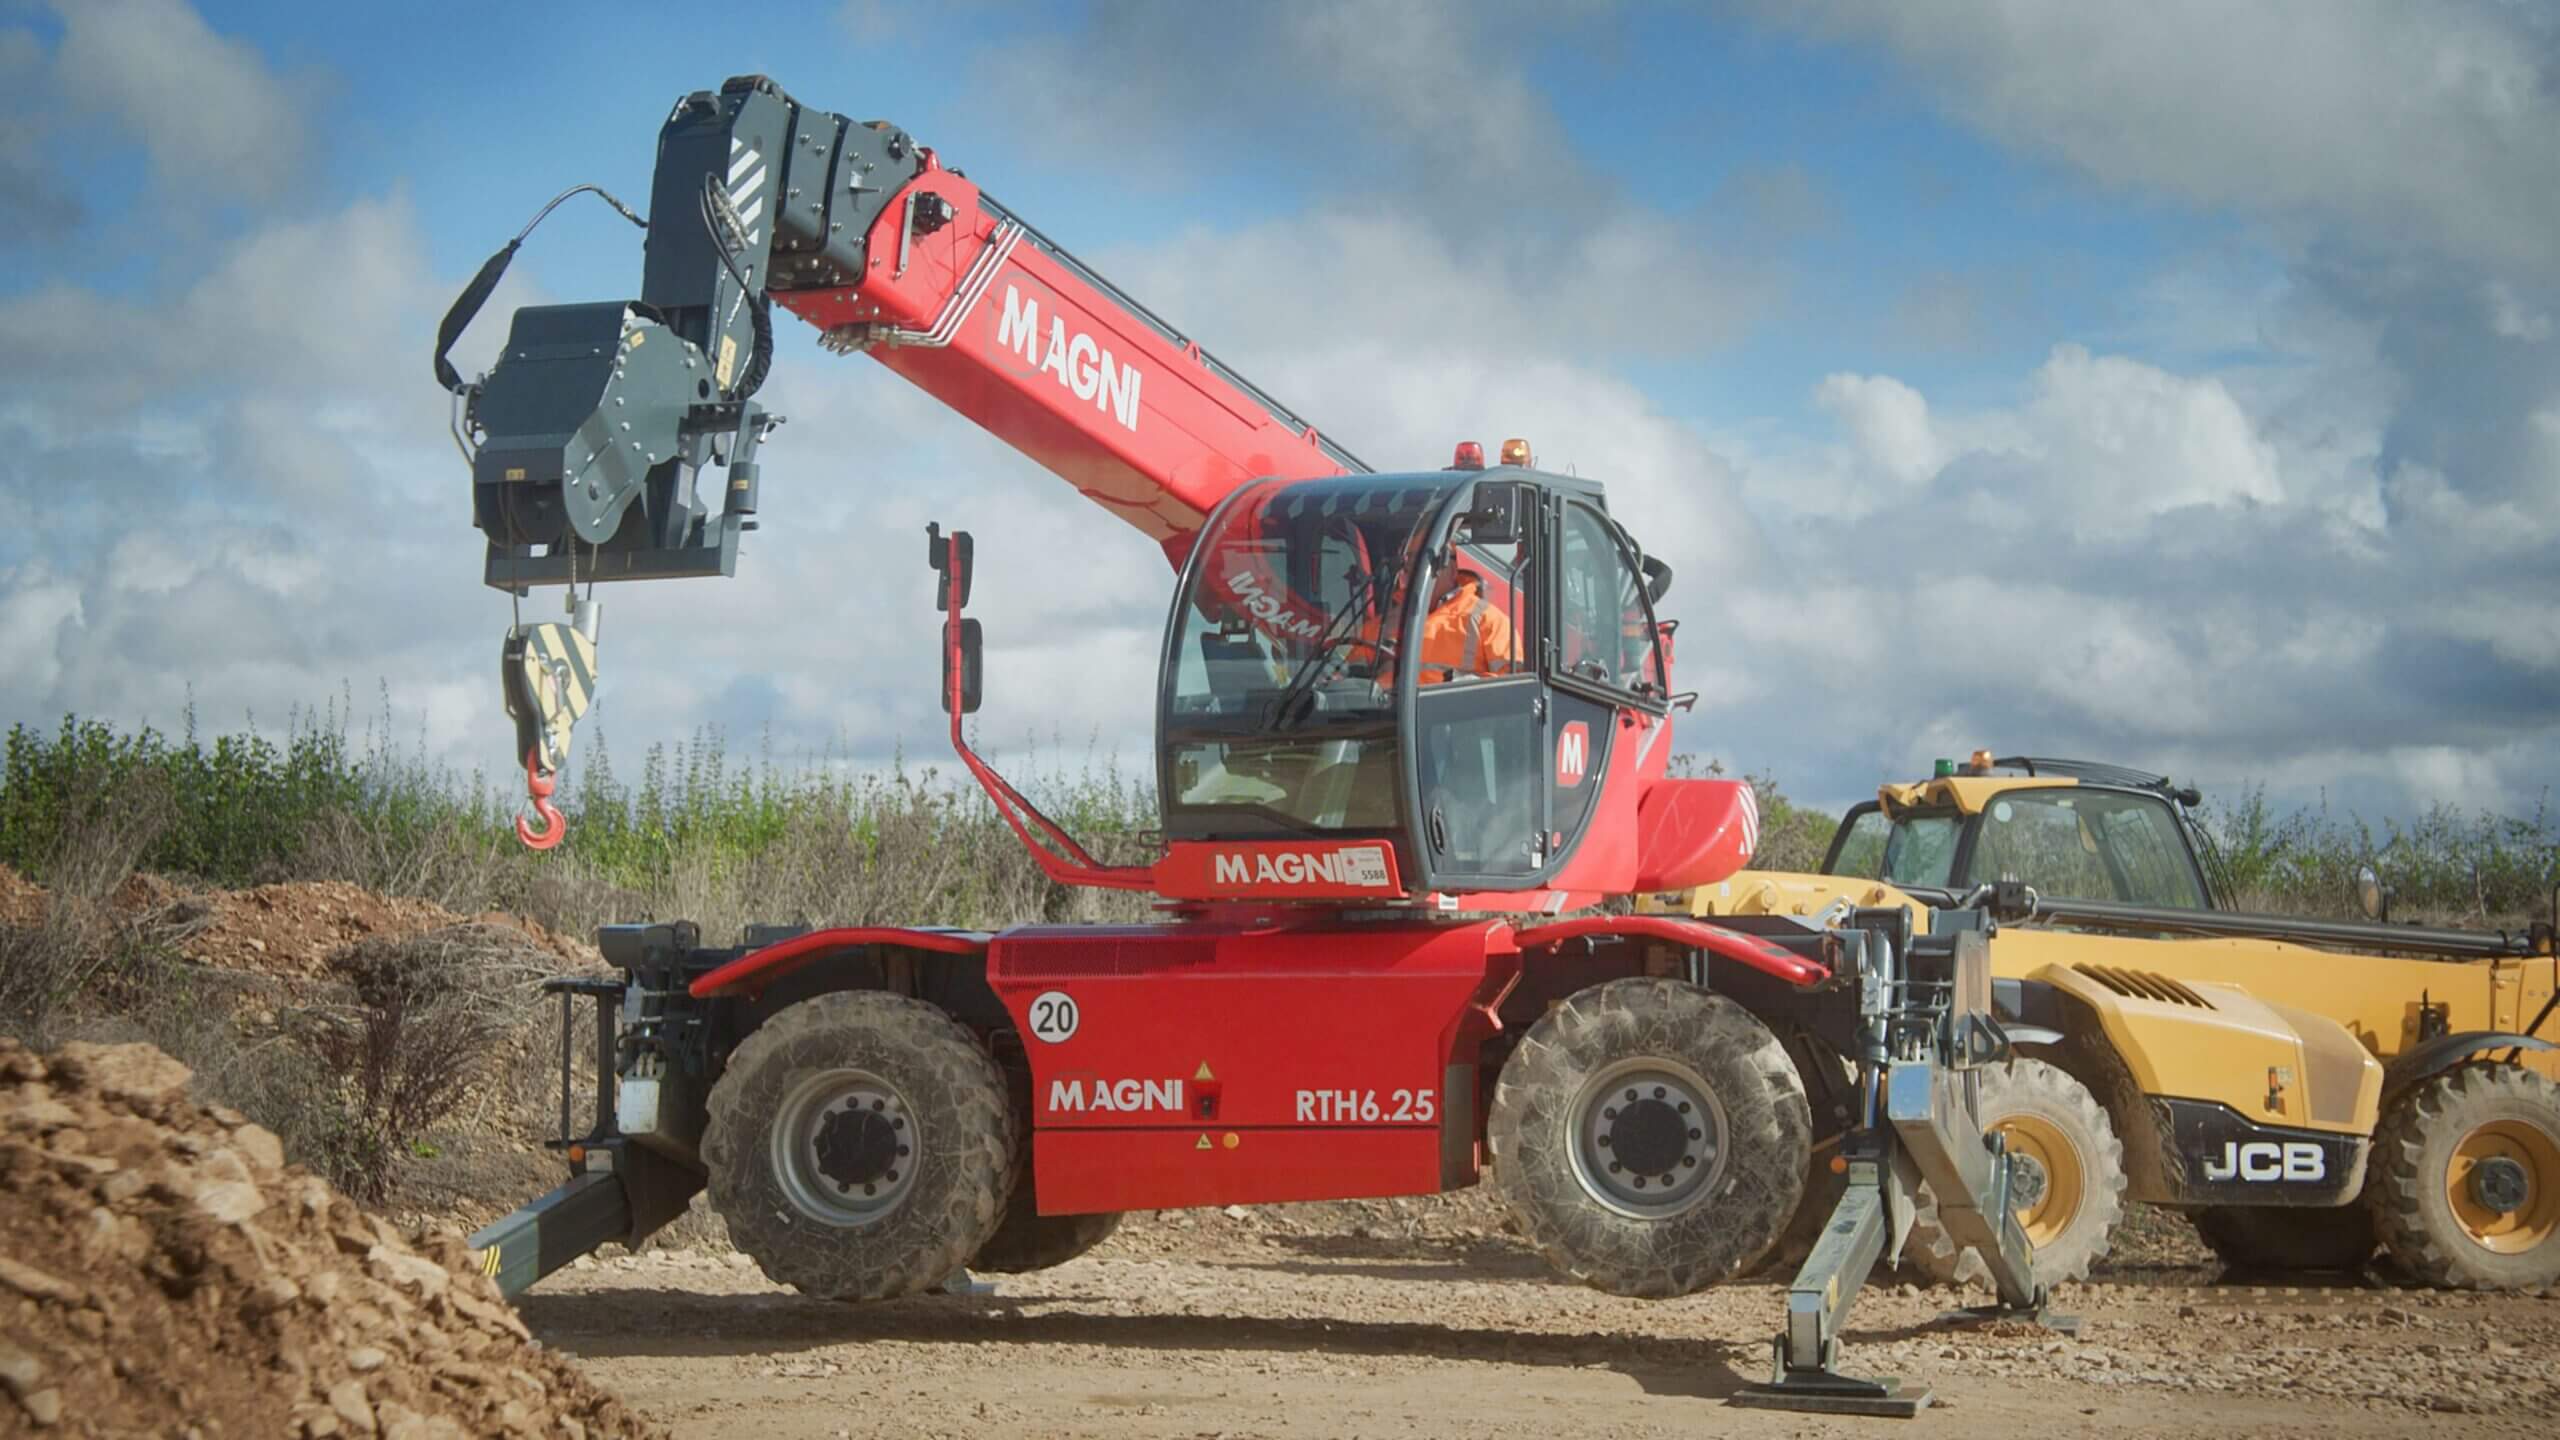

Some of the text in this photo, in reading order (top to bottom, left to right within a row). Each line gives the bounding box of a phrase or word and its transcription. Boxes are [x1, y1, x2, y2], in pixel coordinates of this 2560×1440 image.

[997, 284, 1142, 432] MAGNI
[1561, 732, 1583, 775] M
[1215, 853, 1345, 883] MAGNI
[1035, 1000, 1074, 1034] 20
[1048, 1080, 1184, 1111] MAGNI
[1295, 1090, 1435, 1121] RTH6.25
[2204, 1142, 2325, 1181] JCB
